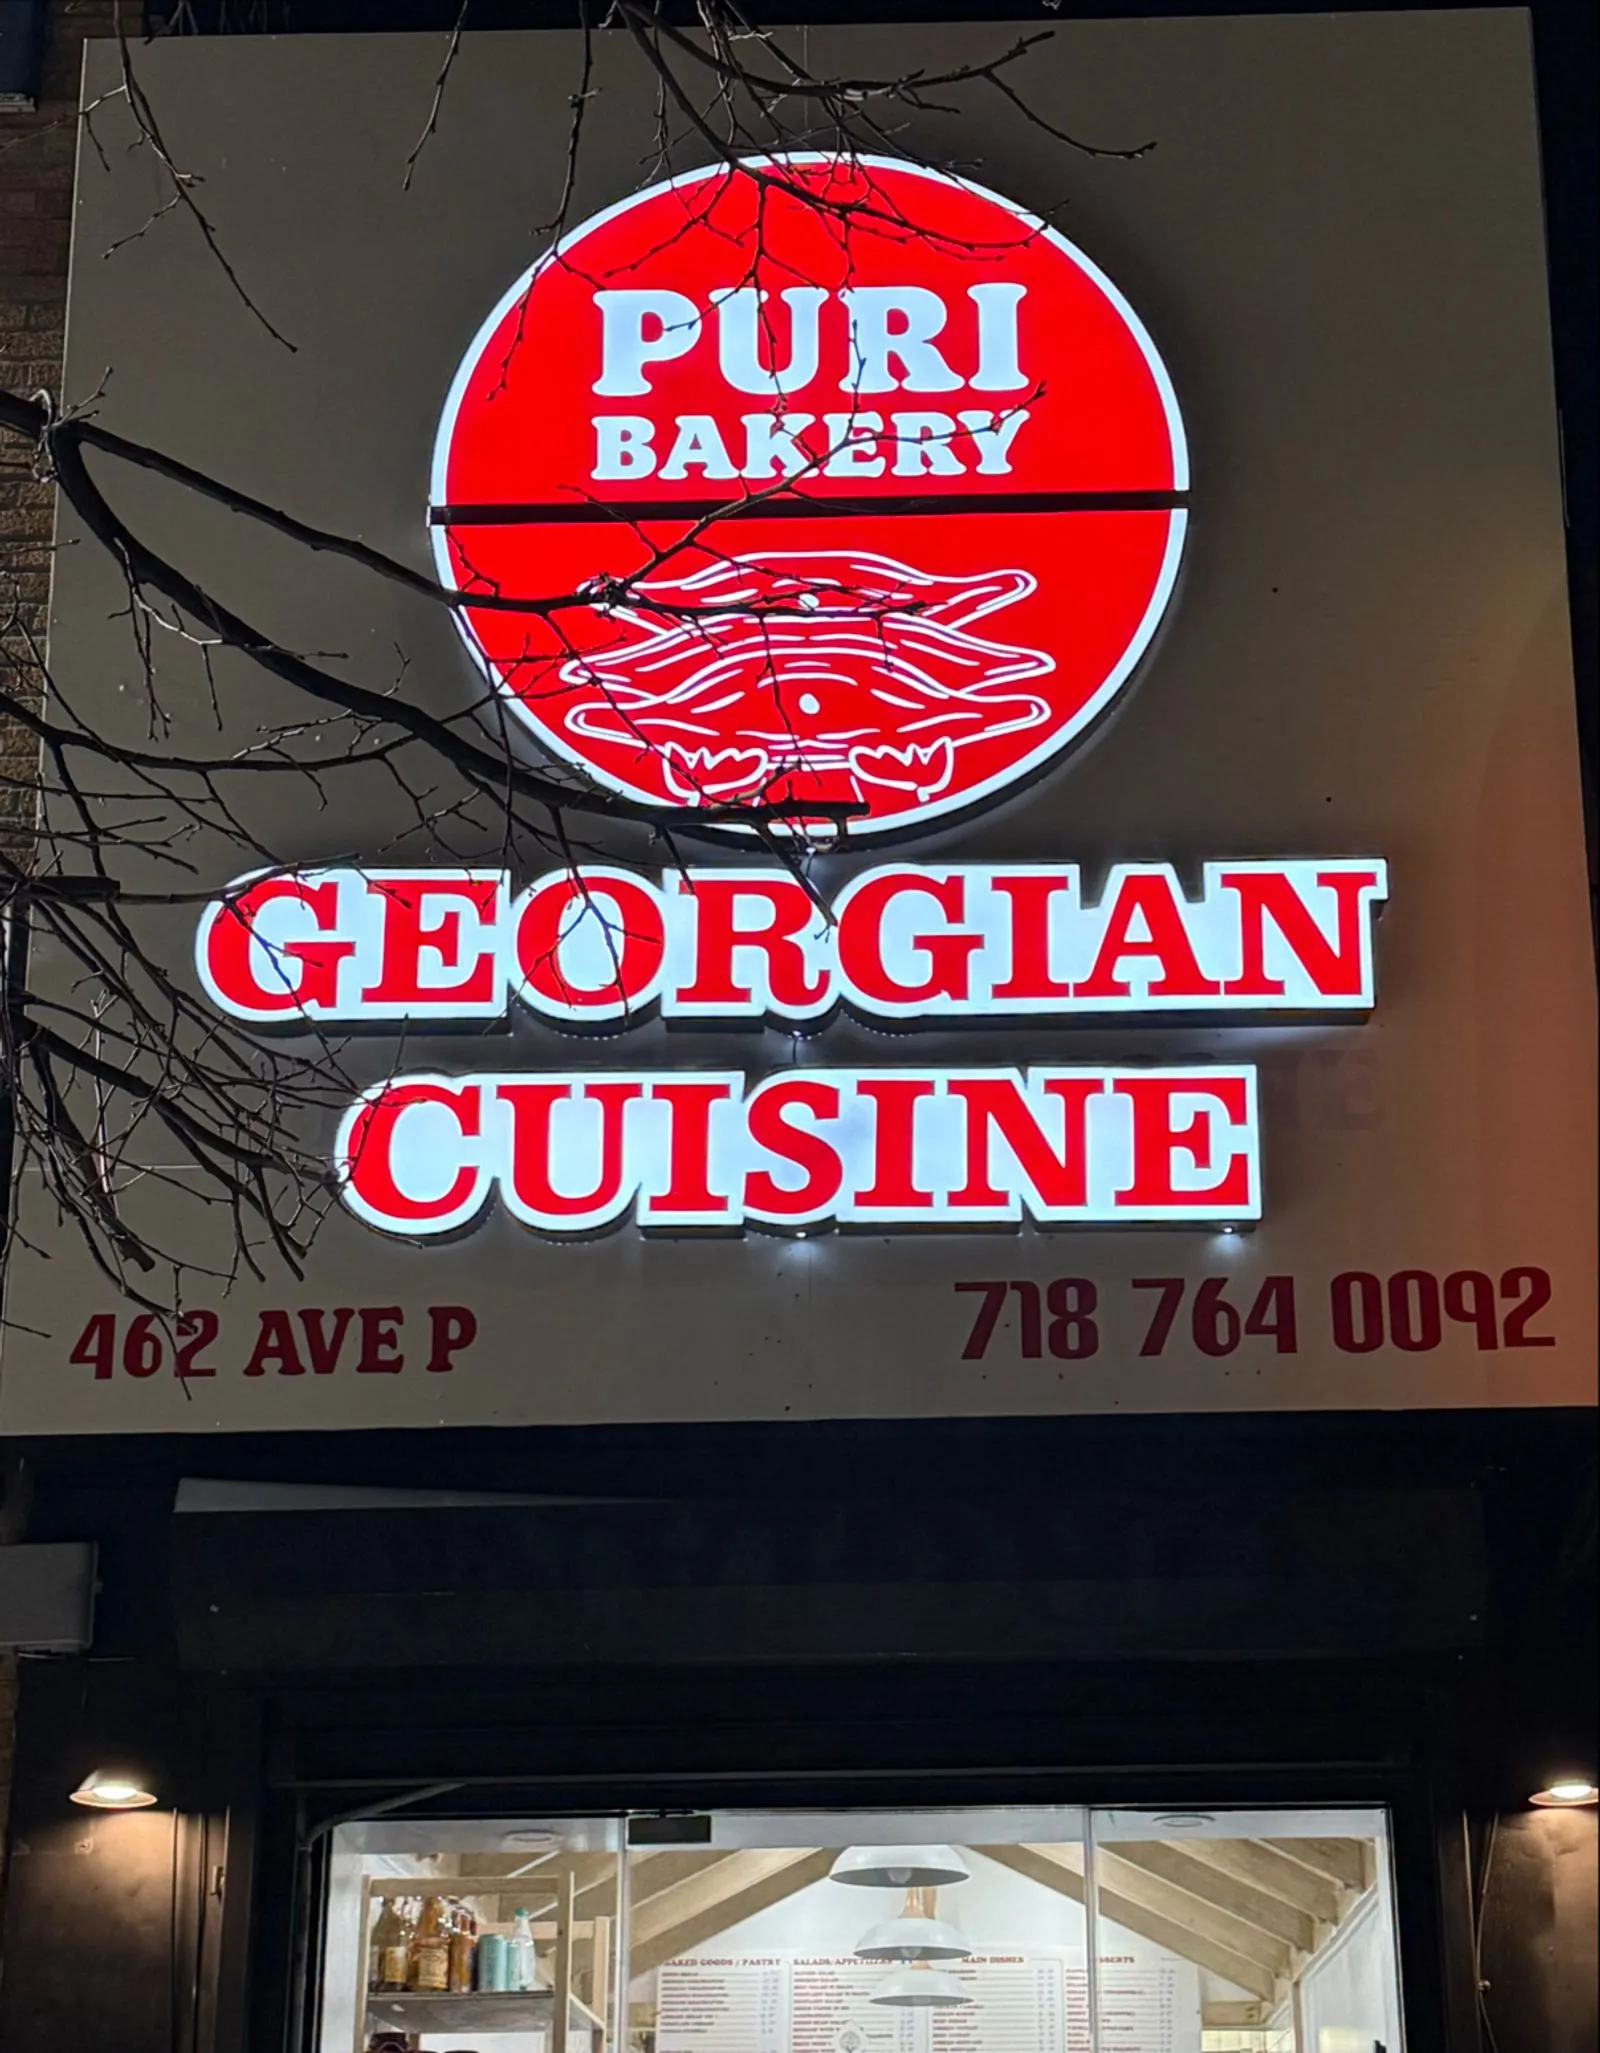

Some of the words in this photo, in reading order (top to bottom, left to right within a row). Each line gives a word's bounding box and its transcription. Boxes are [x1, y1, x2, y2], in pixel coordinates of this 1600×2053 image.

[592, 282, 1029, 396] PURI
[591, 410, 1030, 480] BAKERY
[206, 870, 1378, 1012] GEORGIAN
[345, 1076, 1250, 1220] CUISINE
[69, 1310, 219, 1380] 462
[243, 1306, 405, 1376] AVE
[426, 1305, 478, 1373] P
[954, 1277, 1099, 1361] 718
[1131, 1275, 1298, 1357] 764
[1330, 1266, 1557, 1354] 0092
